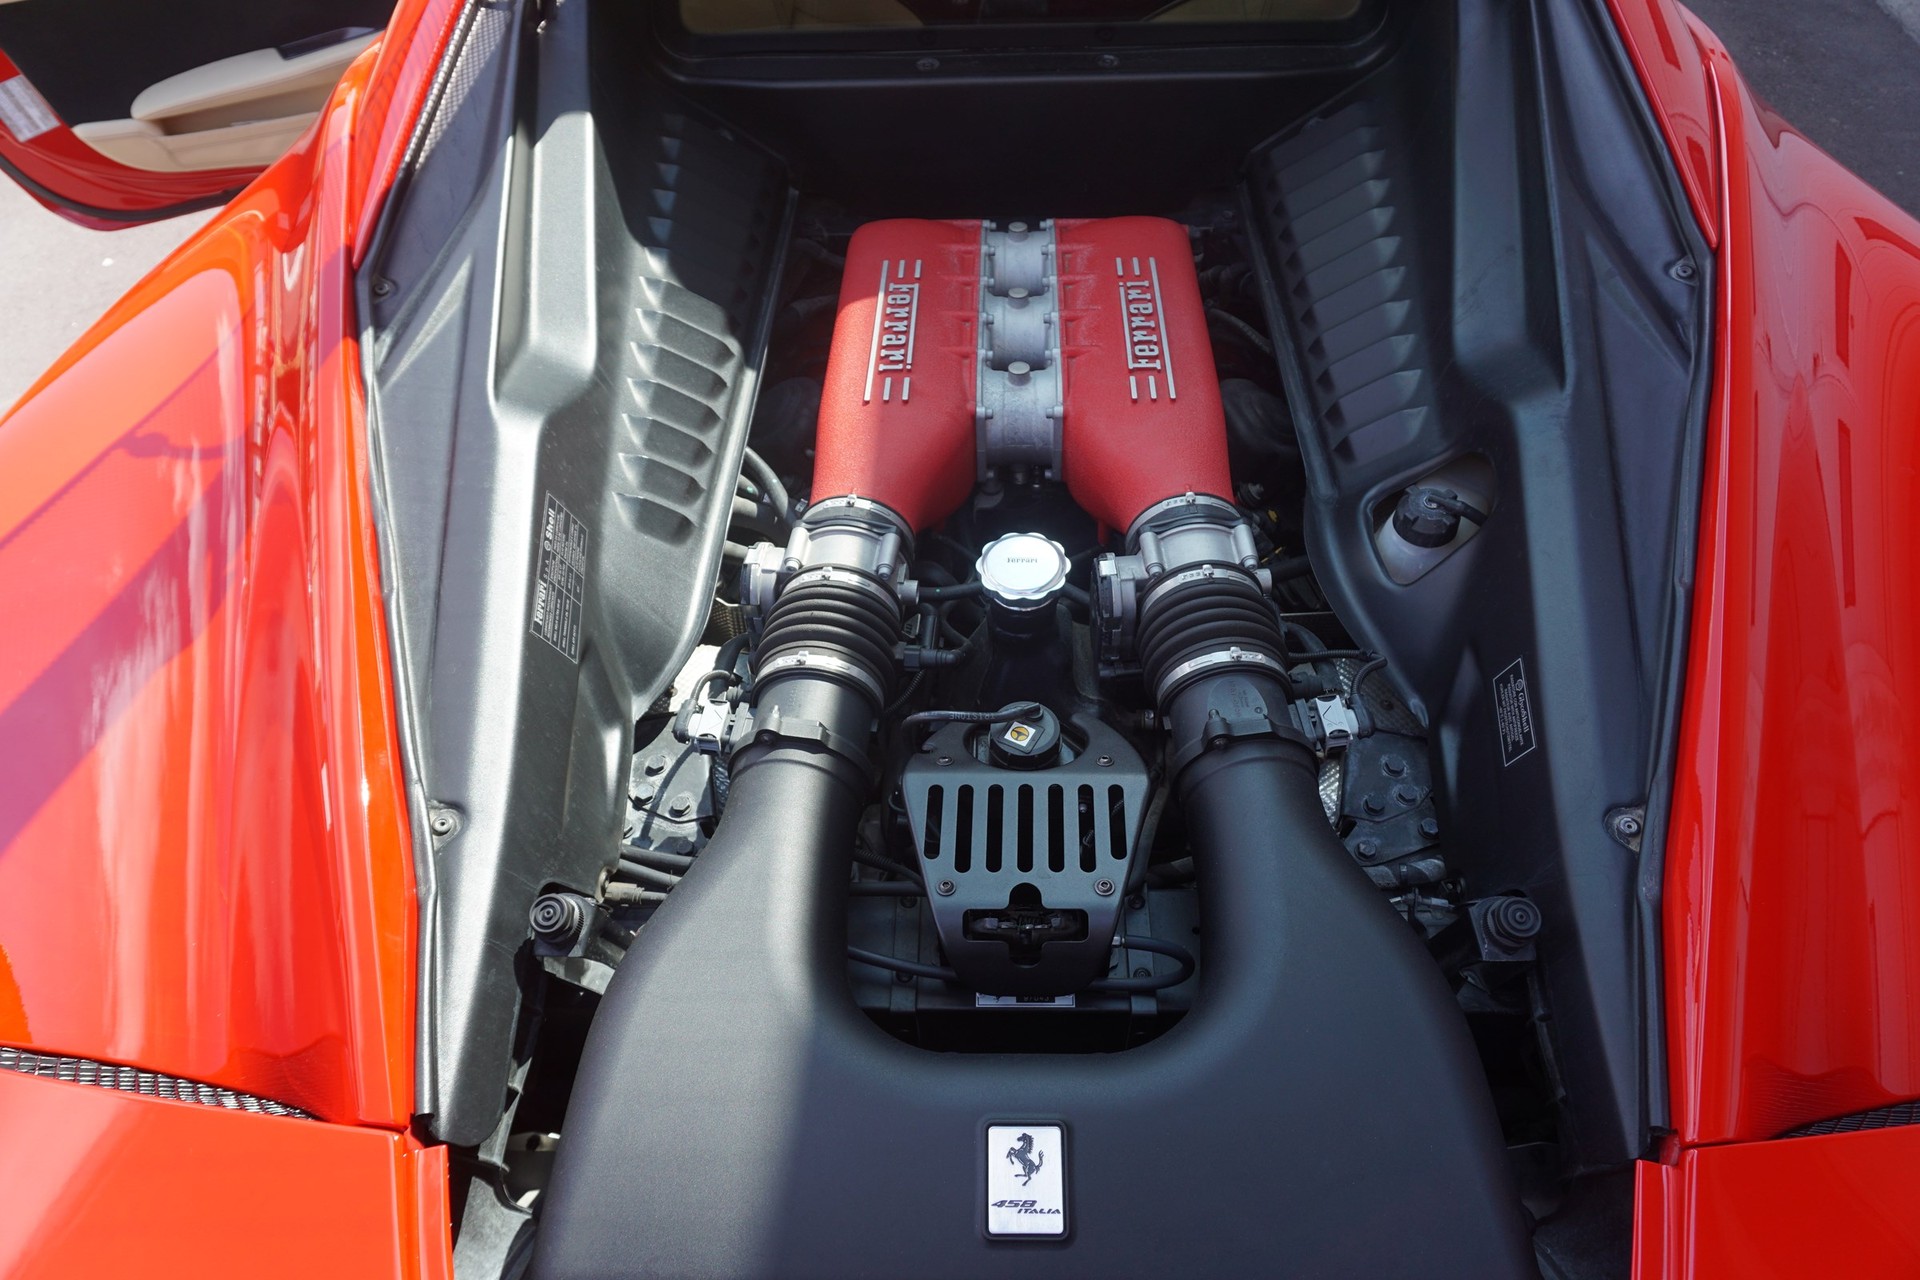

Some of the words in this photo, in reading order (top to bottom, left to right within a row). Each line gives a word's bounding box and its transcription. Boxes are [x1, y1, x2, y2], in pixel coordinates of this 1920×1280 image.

[878, 283, 920, 371] Ferrari
[1119, 281, 1161, 370] Ferrari
[545, 507, 555, 540] Shell
[1007, 556, 1038, 564] Ferrari
[534, 579, 547, 626] Ferrari
[991, 1199, 1038, 1208] 458
